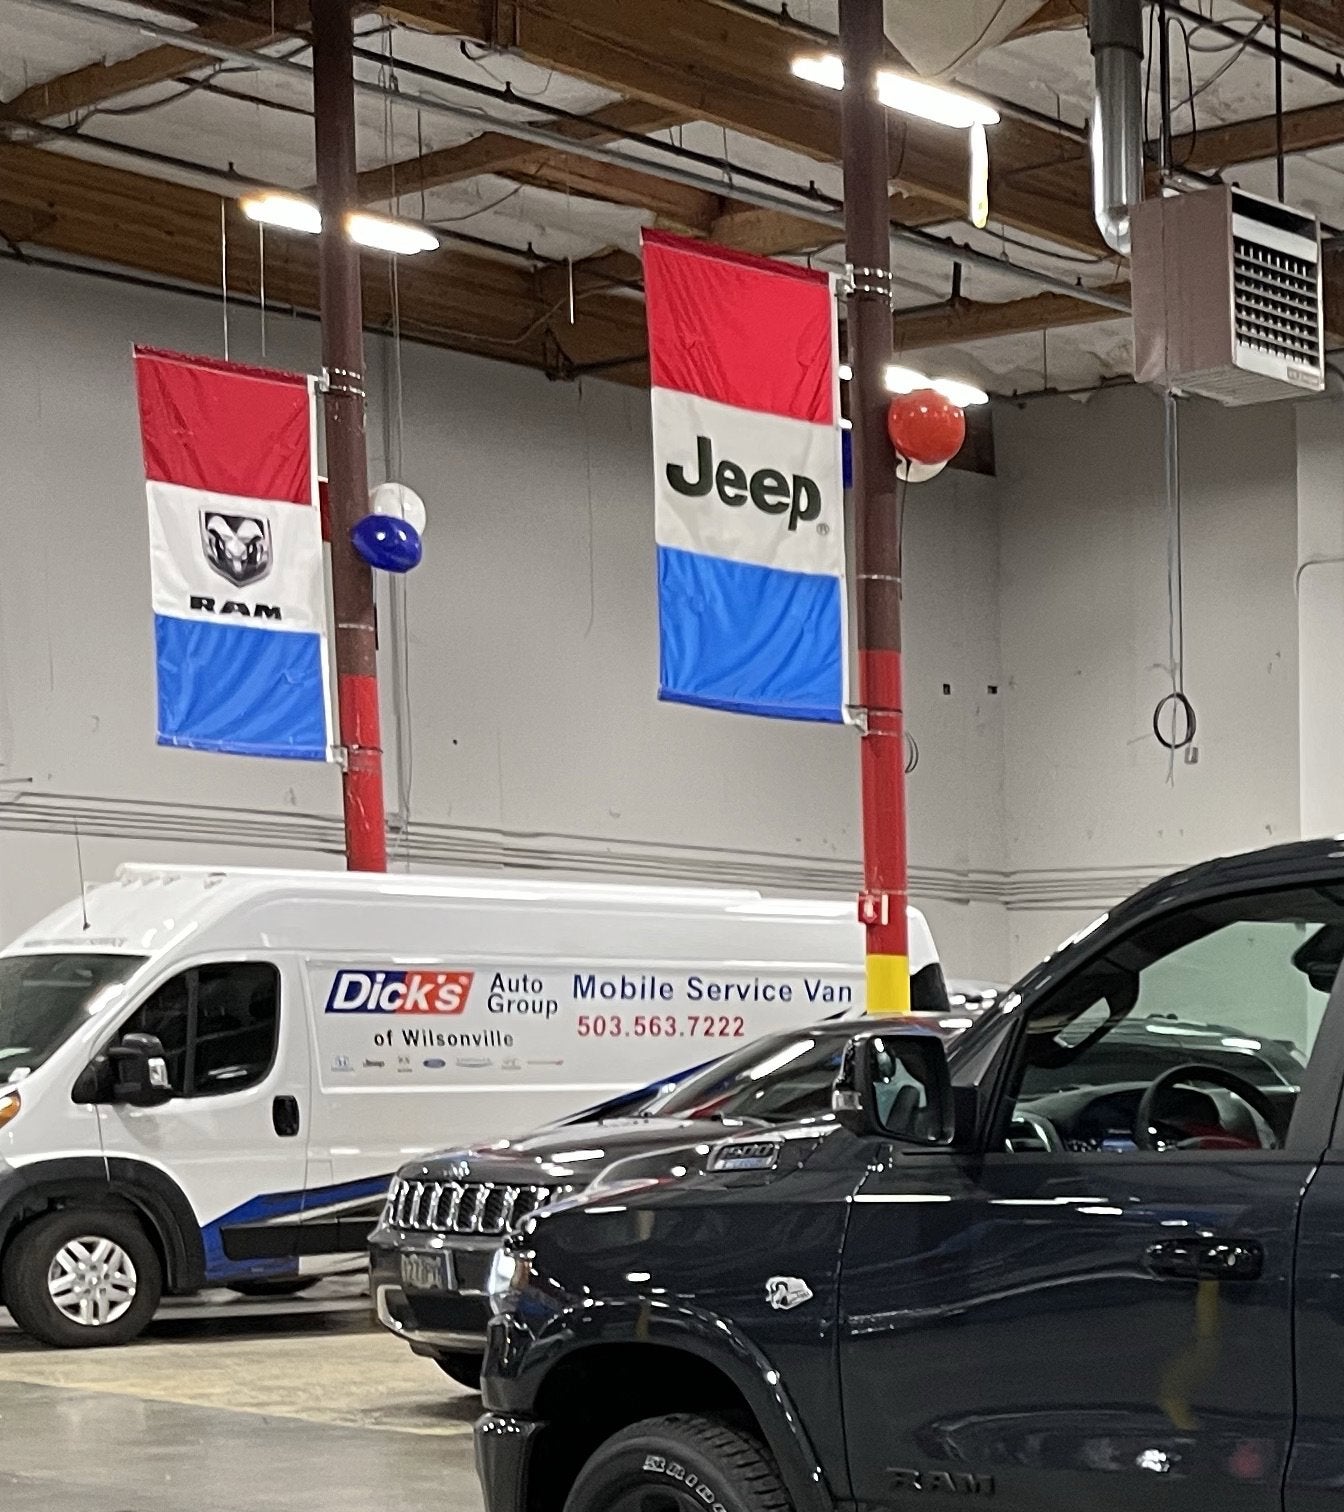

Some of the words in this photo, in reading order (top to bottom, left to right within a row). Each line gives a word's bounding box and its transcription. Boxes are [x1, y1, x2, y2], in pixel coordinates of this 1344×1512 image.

[666, 435, 822, 532] Jeep
[190, 595, 282, 620] RAM
[333, 973, 464, 1010] Dick's
[490, 973, 543, 994] Auto
[572, 974, 675, 1001] Mobile
[686, 976, 793, 1001] Service
[803, 979, 853, 1003] Van
[487, 994, 559, 1018] Group
[374, 1029, 392, 1046] of
[401, 1029, 514, 1047] Wilsonville
[577, 1015, 745, 1037] 503.563.7222
